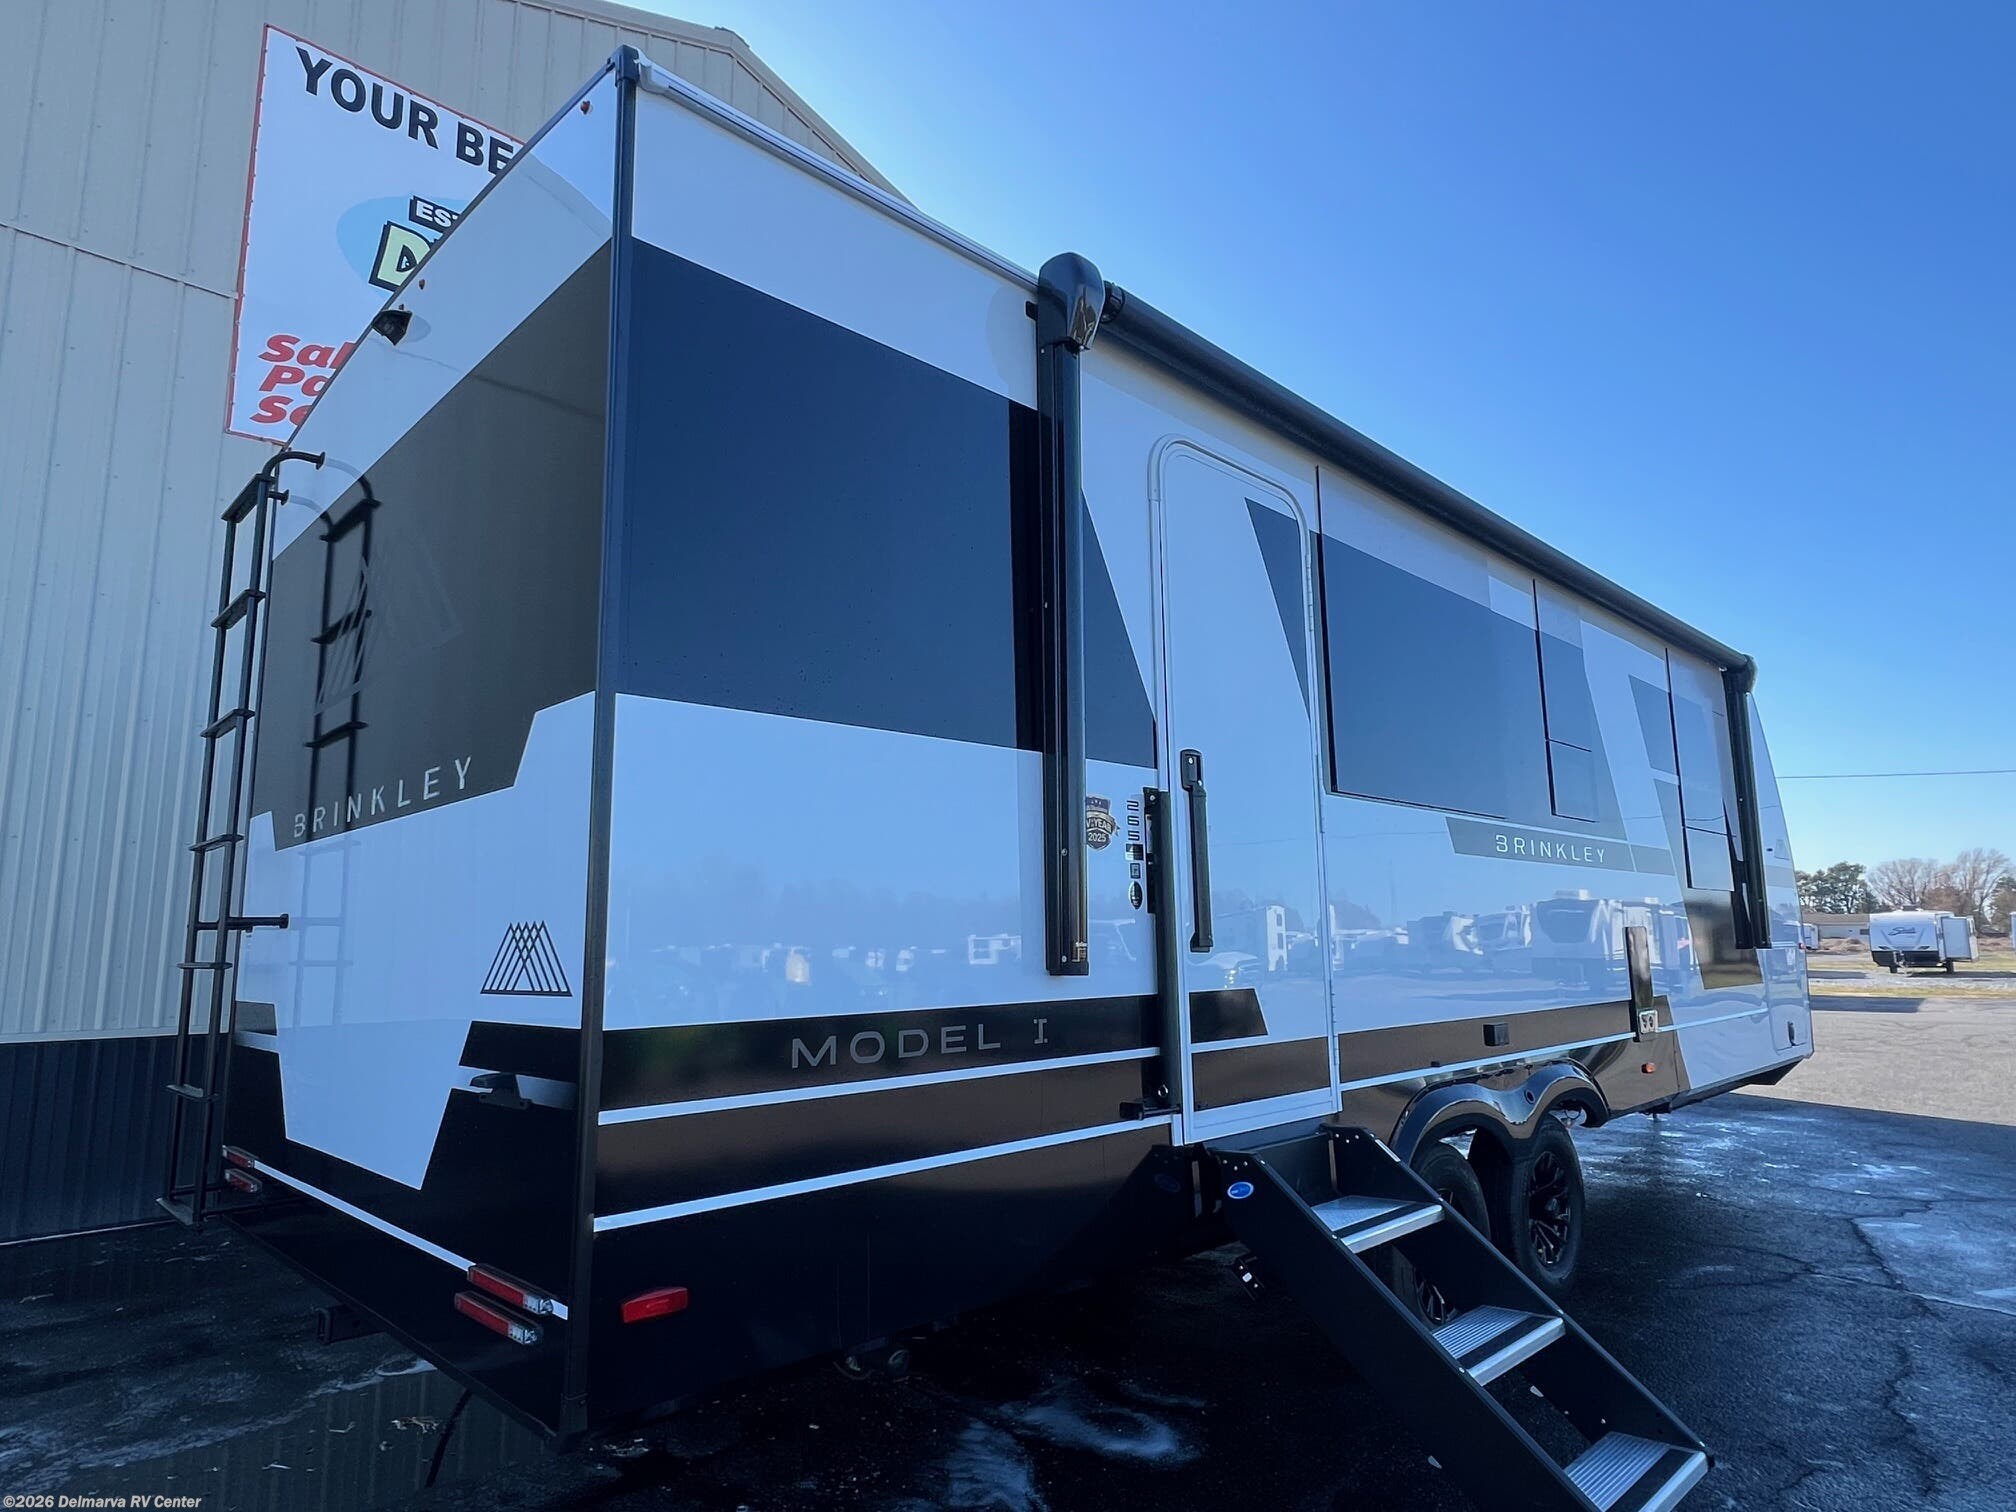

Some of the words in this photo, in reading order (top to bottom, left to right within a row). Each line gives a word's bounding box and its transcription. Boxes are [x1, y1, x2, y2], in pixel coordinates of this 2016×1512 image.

[296, 46, 439, 149] YOUR
[415, 199, 458, 228] ES
[293, 756, 472, 838] BRINKLEY
[1088, 832, 1107, 843] 2025
[1495, 834, 1606, 864] BRINKLEY
[791, 1023, 1001, 1069] MODEL
